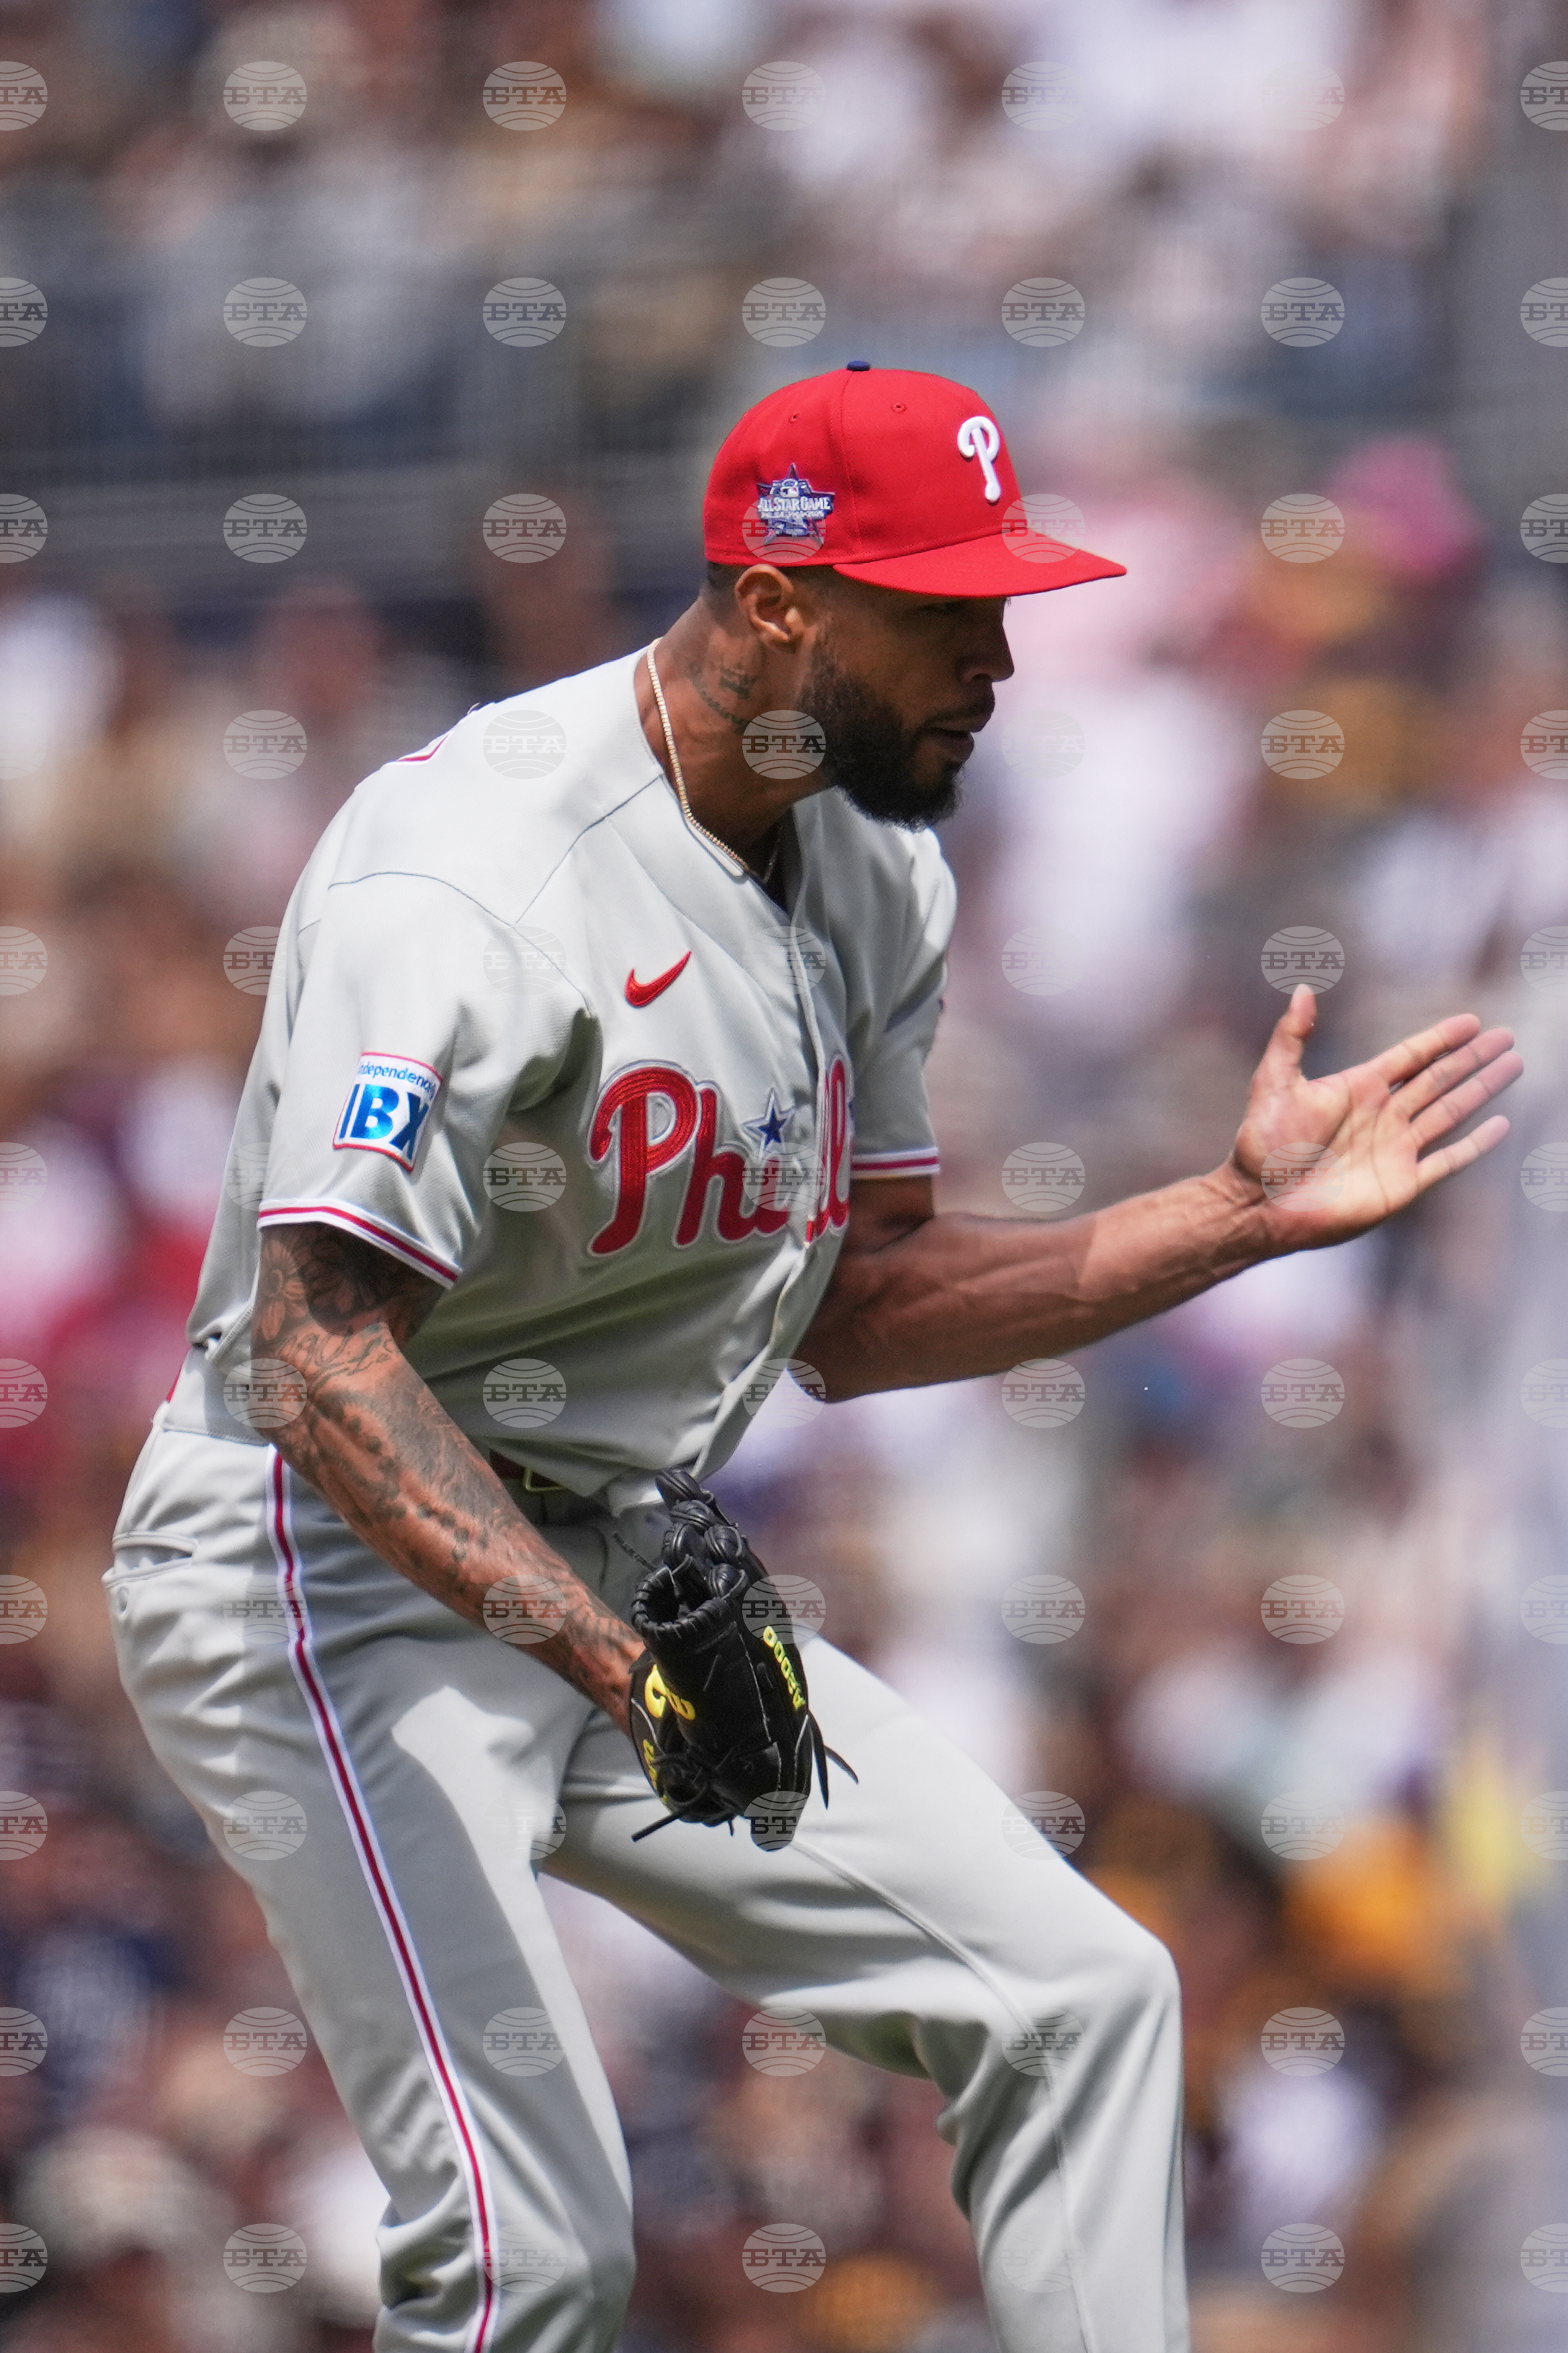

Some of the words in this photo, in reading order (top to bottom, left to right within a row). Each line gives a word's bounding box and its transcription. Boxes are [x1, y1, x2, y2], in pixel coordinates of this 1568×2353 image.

[957, 416, 1000, 502] P
[800, 496, 831, 511] GAME
[339, 1083, 430, 1161] IBX
